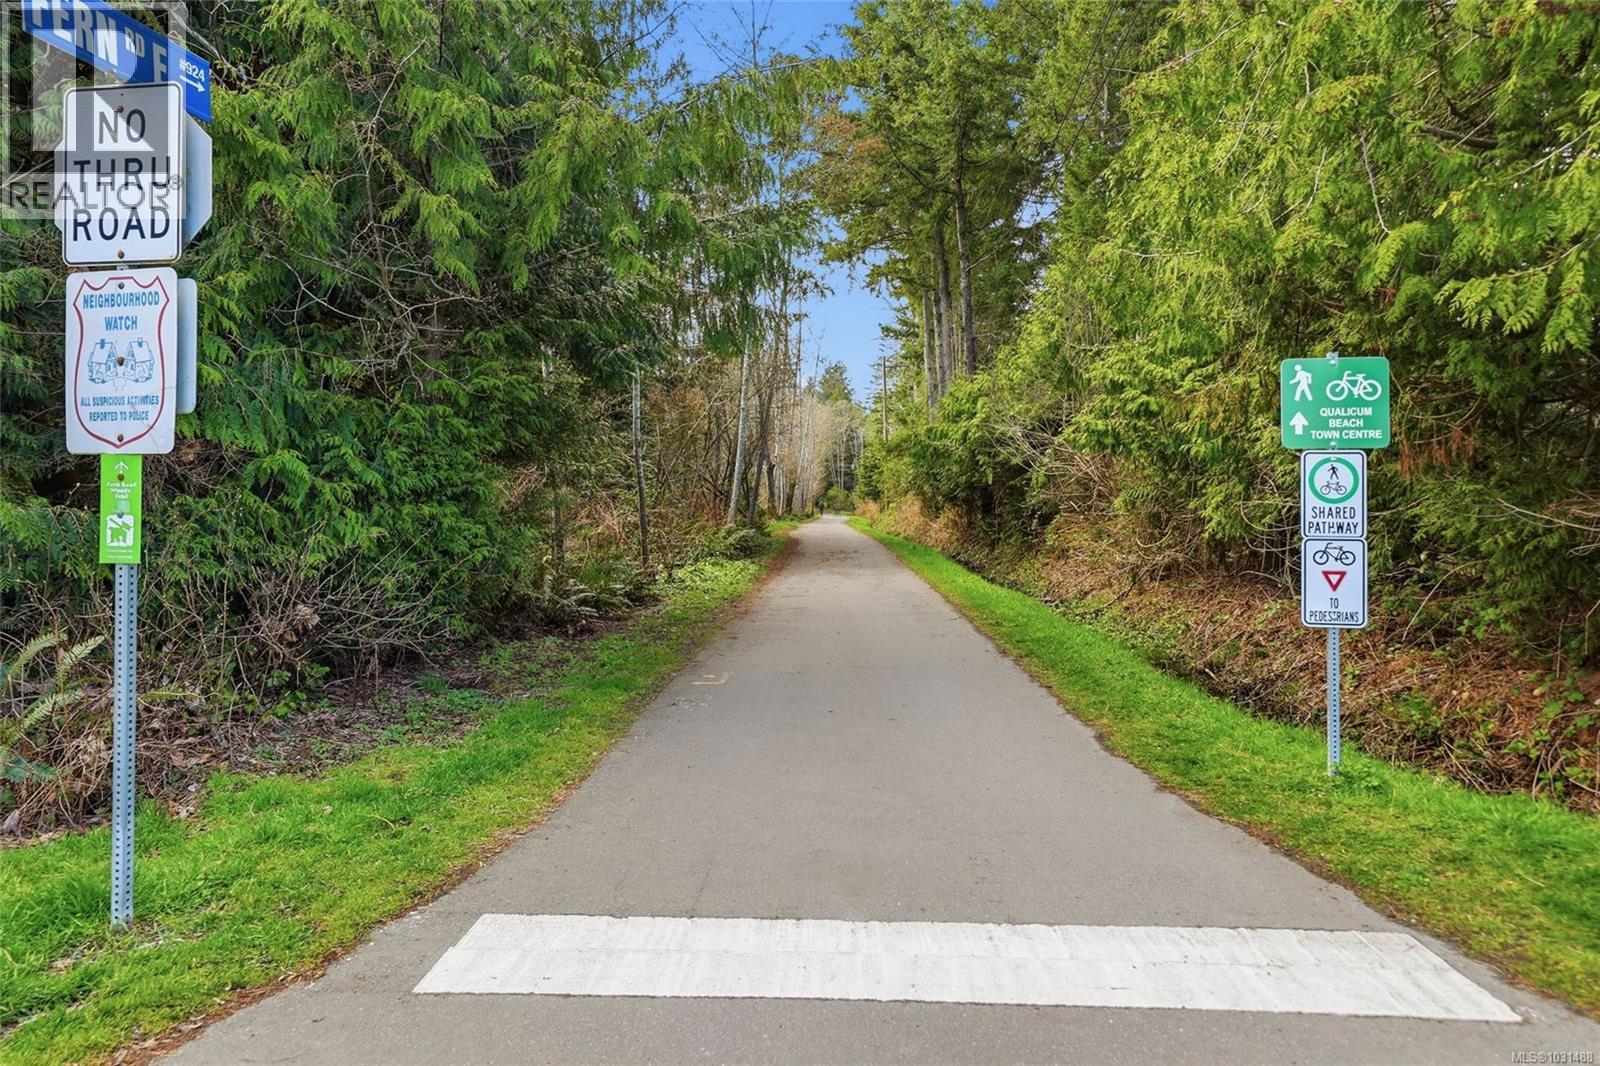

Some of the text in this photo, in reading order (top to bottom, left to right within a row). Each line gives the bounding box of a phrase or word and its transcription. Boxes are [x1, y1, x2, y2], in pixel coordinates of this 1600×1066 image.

[31, 0, 119, 67] FERN
[124, 27, 145, 58] RD
[179, 58, 205, 82] #924
[98, 108, 146, 144] NO
[73, 156, 170, 193] THRU
[73, 206, 170, 241] ROAD
[83, 291, 160, 309] NEIGHBOURHOOD
[104, 316, 138, 331] WATCH
[80, 394, 160, 407] ALL SUSPICIOUS ACTIVITIES
[89, 410, 149, 422] REPORTED TO POLICE
[1320, 407, 1372, 416] QUALICUM
[1329, 418, 1364, 428] BEACH
[1311, 430, 1383, 439] TOWN CENTRE
[1311, 506, 1356, 519] SHARED
[1308, 521, 1359, 534] PATHWAY
[1329, 597, 1339, 609] TO
[1309, 610, 1359, 623] PEDESTRIANS
